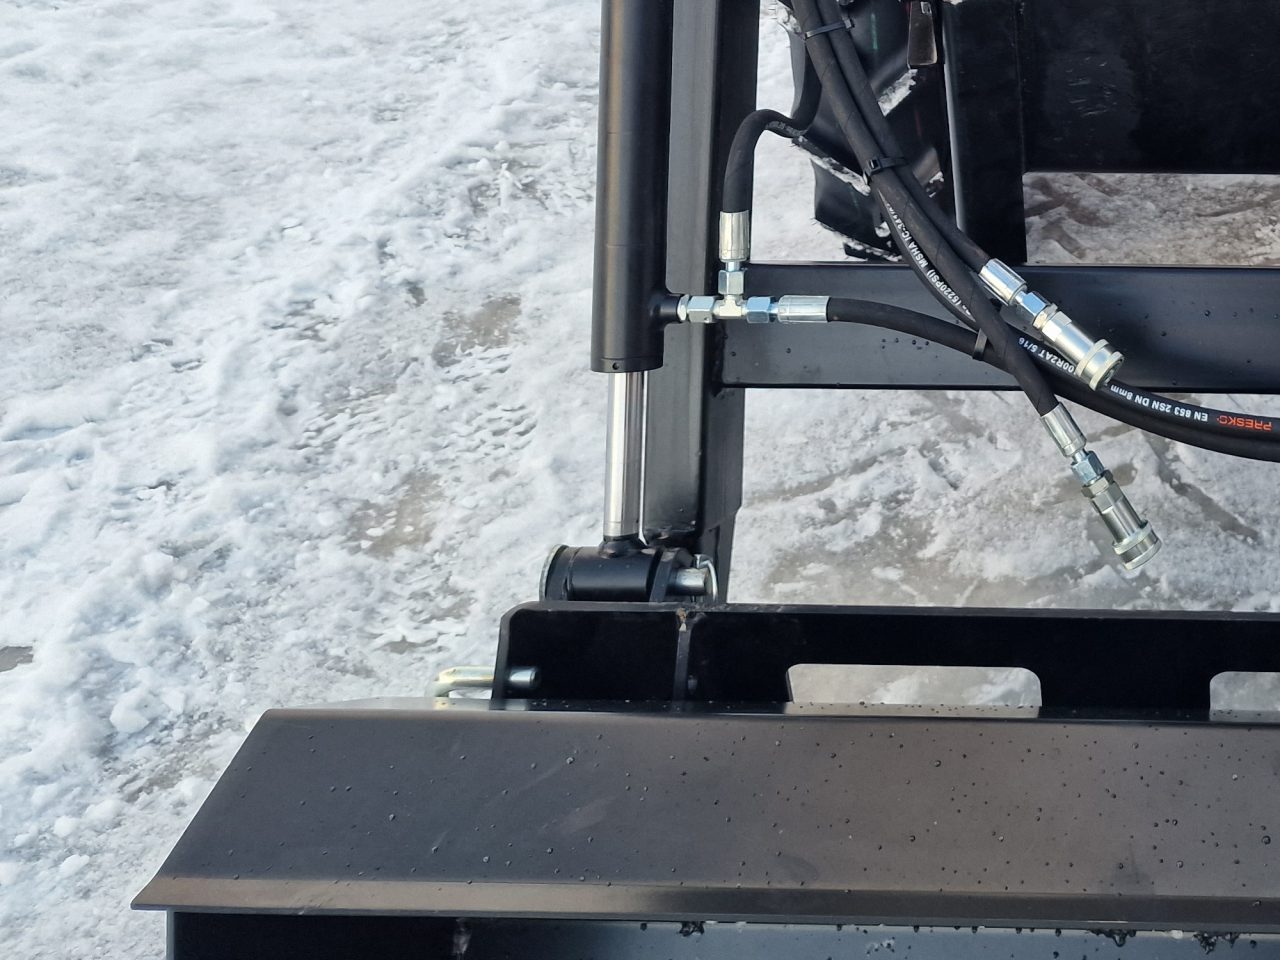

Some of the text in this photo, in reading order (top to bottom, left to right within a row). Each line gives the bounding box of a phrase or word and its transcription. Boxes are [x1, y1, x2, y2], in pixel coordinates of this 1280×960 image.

[908, 242, 928, 268] MSHA
[926, 268, 962, 306] (5220PSI)
[1038, 350, 1076, 375] 00R2AT
[1110, 384, 1134, 401] 8mm
[1134, 394, 1150, 407] DN
[1152, 400, 1172, 413] 2SN
[1174, 407, 1191, 418] 853
[1194, 412, 1208, 422] EN
